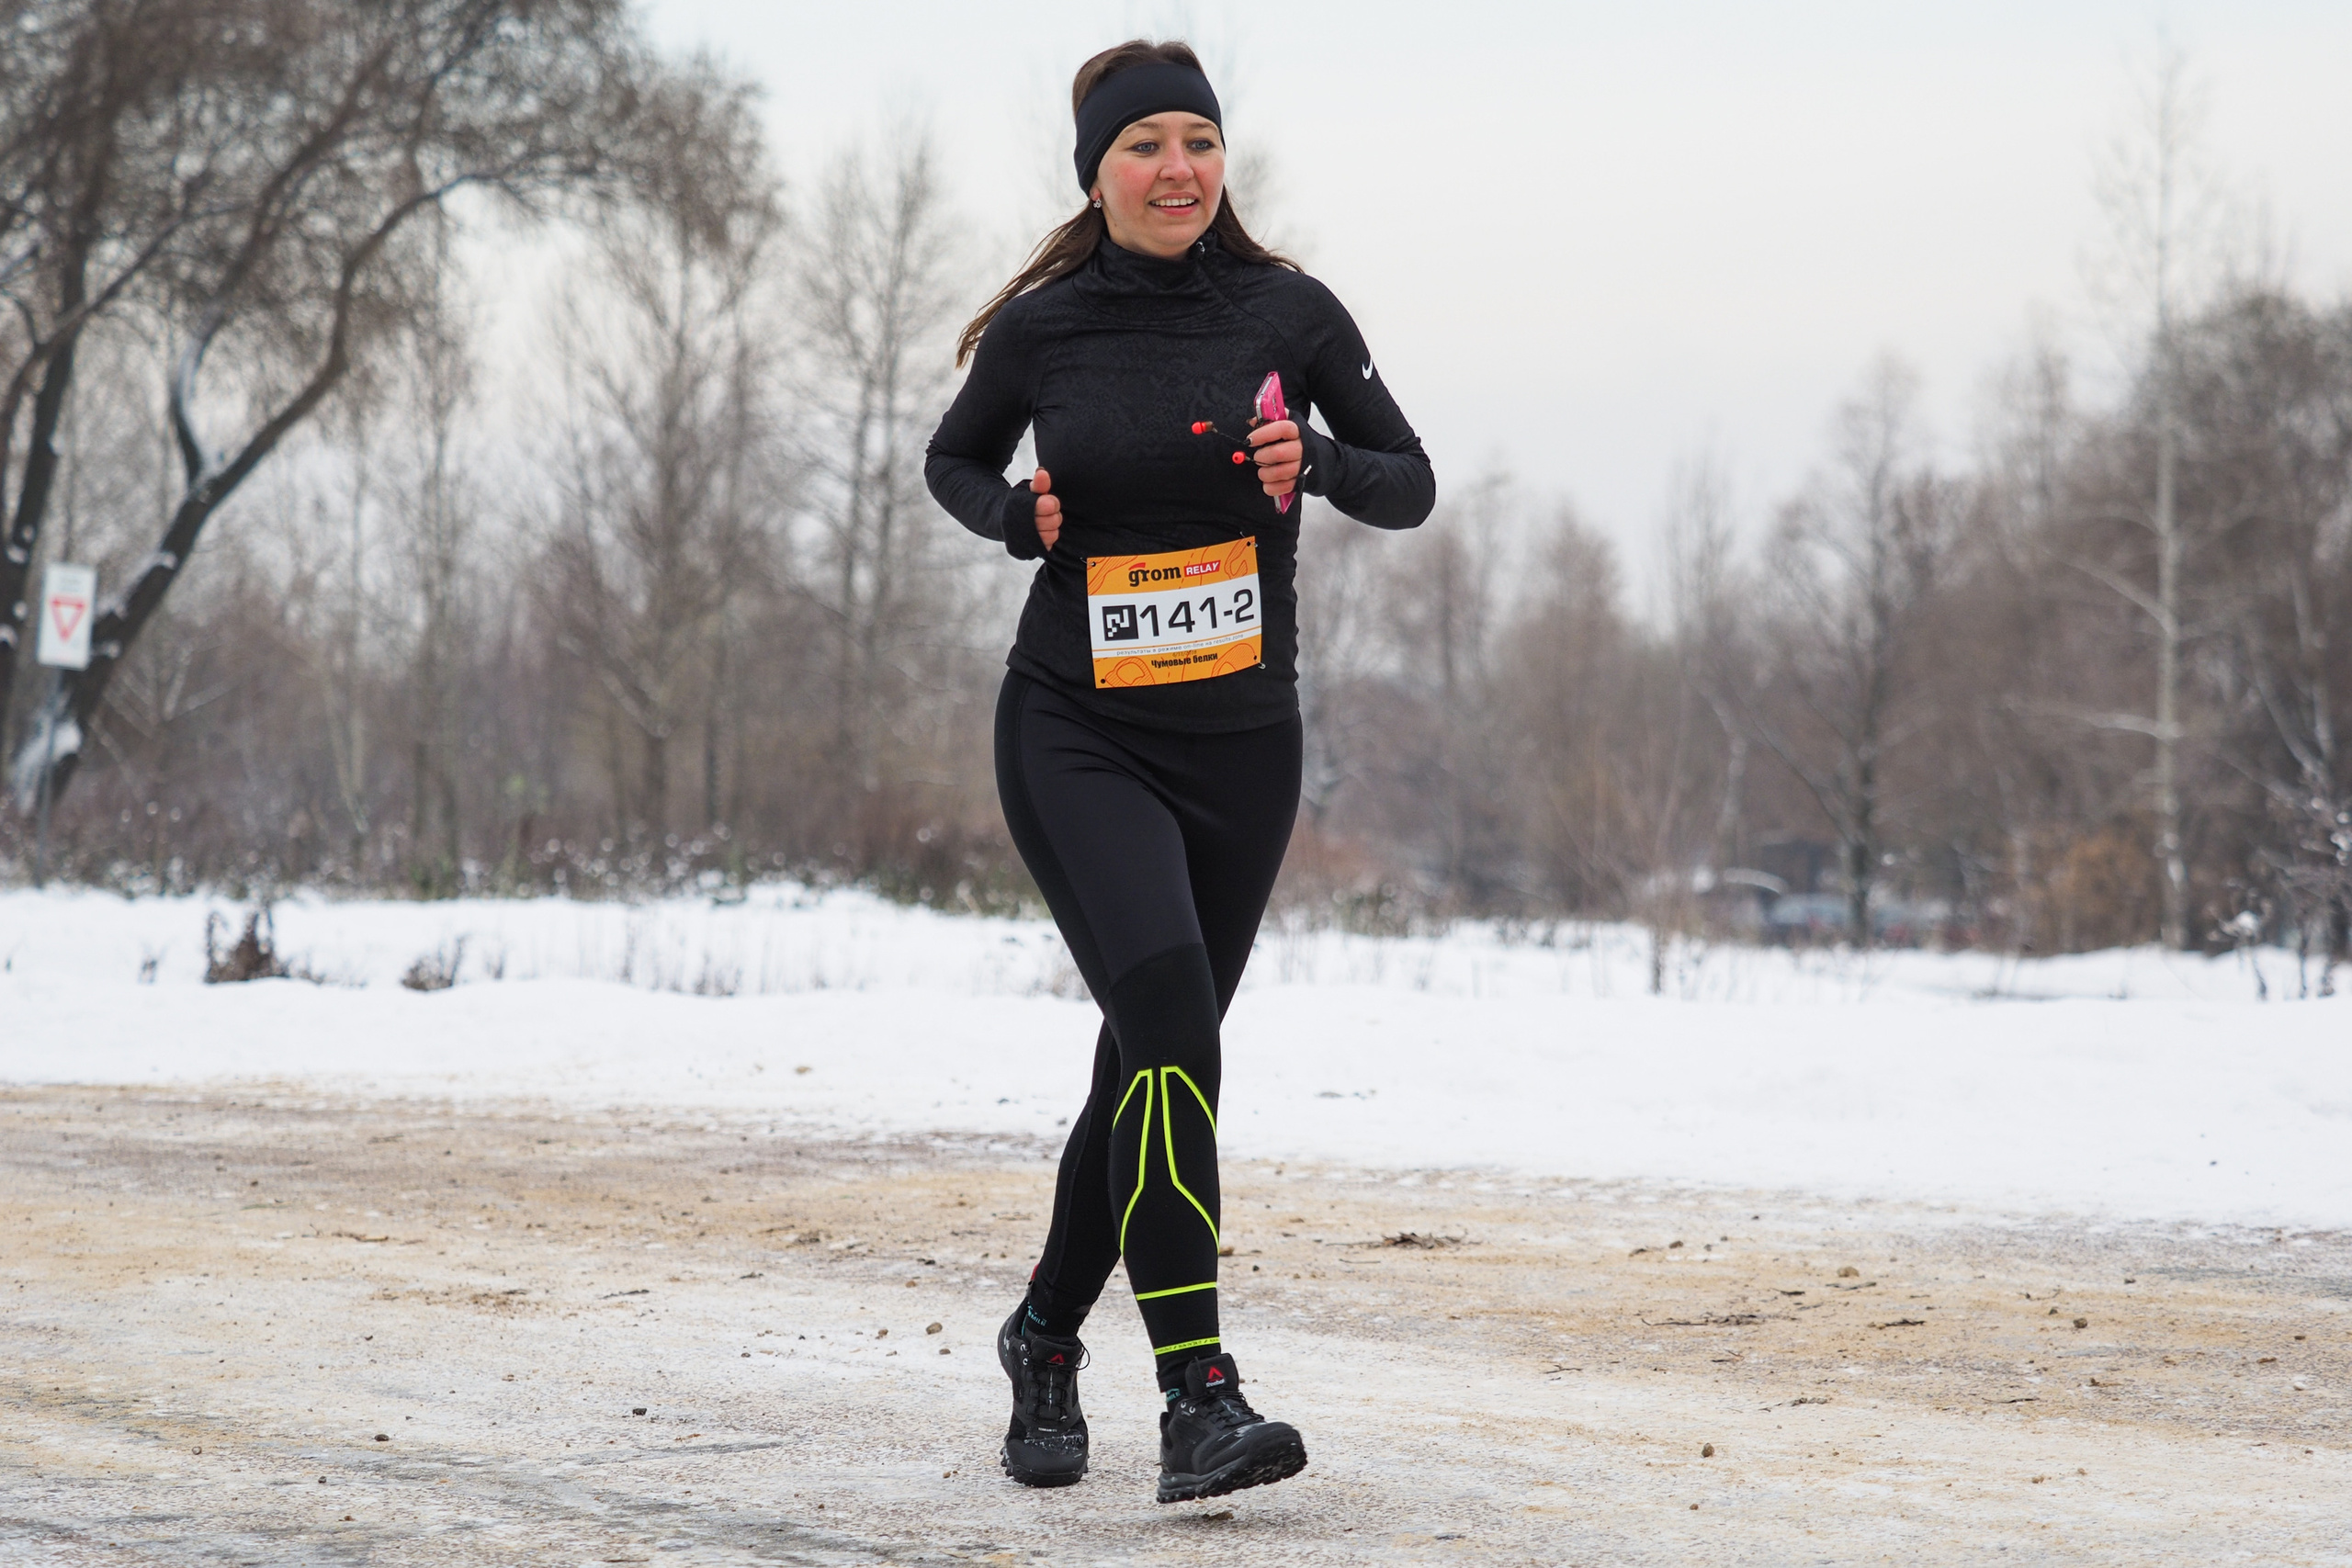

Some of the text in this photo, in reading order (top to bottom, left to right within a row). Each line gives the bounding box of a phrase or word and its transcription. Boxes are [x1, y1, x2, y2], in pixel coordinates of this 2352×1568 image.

[1128, 561, 1220, 587] grom RELAY
[1139, 589, 1254, 637] 141-2
[1151, 653, 1218, 669] Чумовые белки
